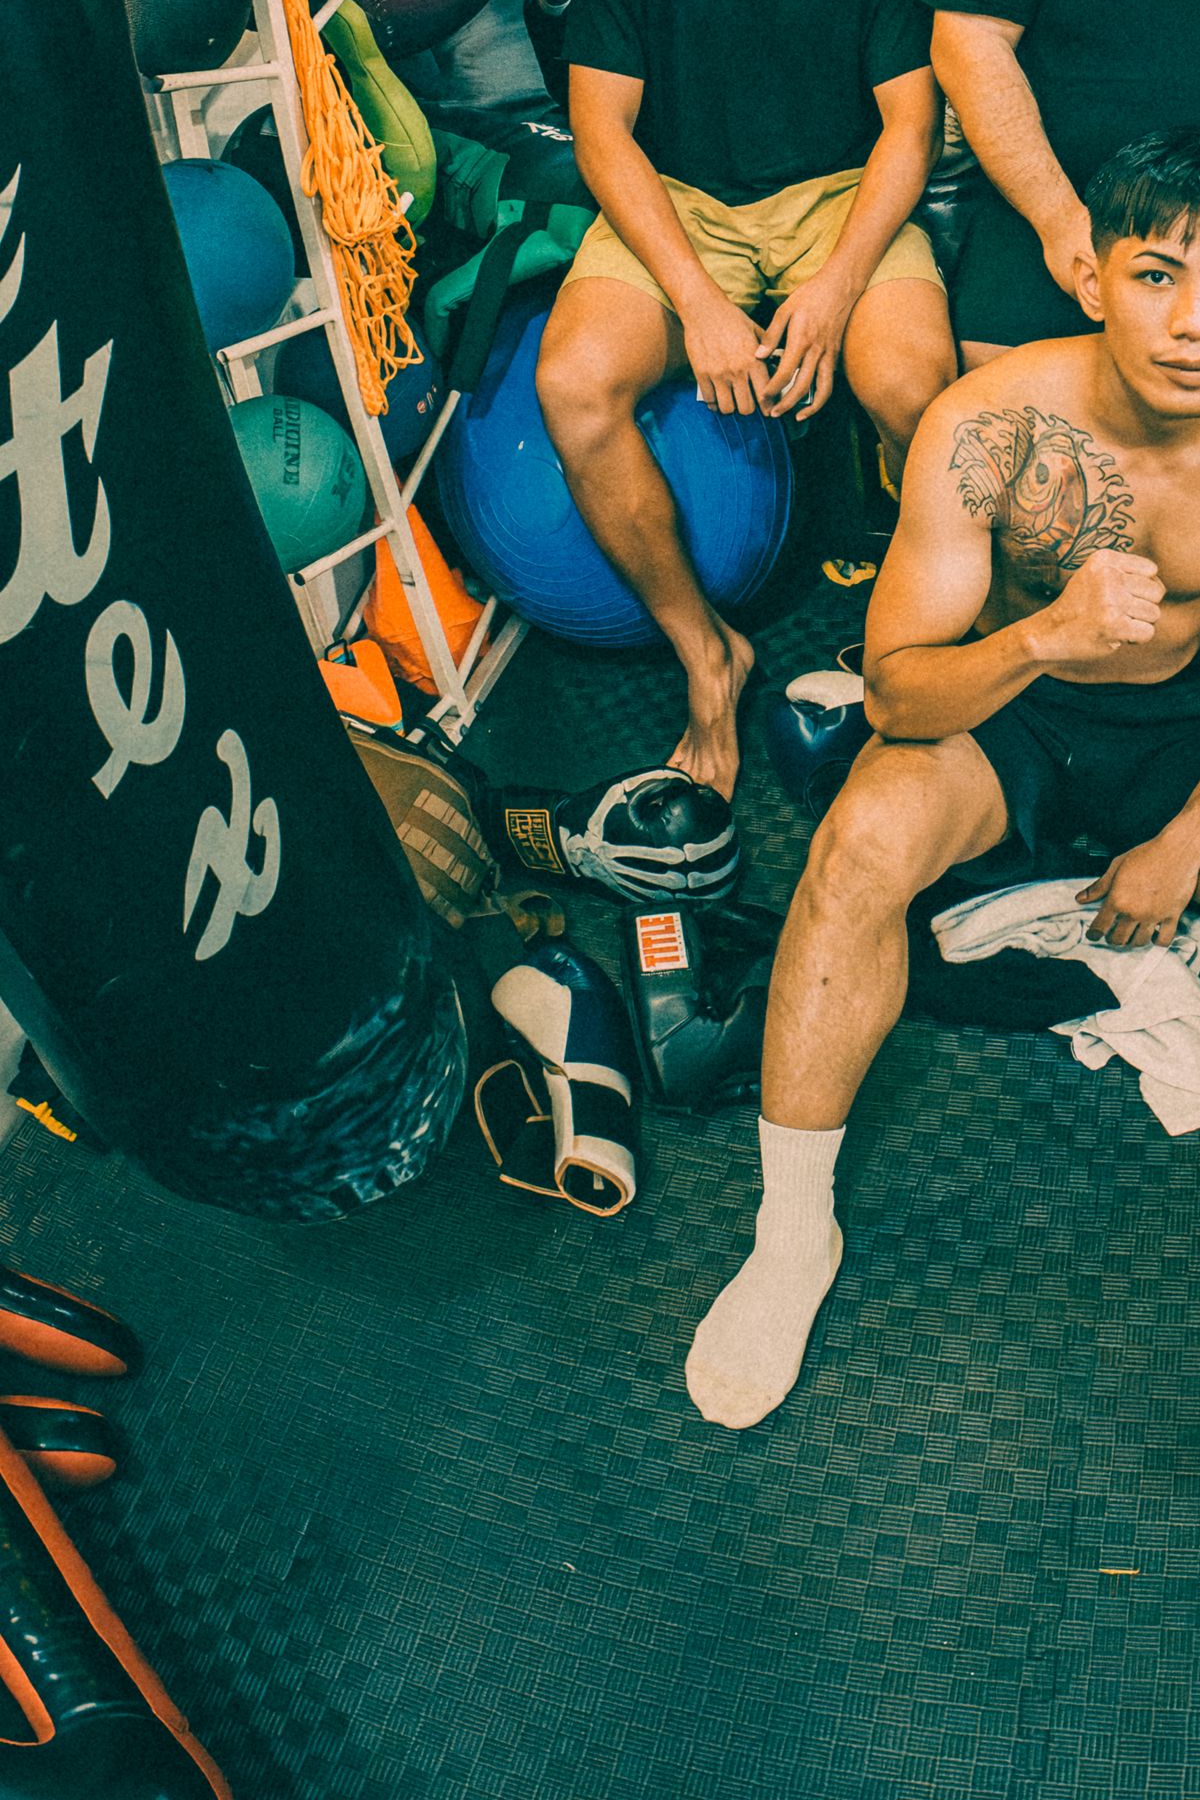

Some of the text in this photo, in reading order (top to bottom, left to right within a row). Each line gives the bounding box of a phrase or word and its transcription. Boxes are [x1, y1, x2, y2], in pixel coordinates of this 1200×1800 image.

[272, 407, 283, 443] BALL
[283, 395, 300, 485] EDICINE
[640, 915, 681, 969] TITLE
